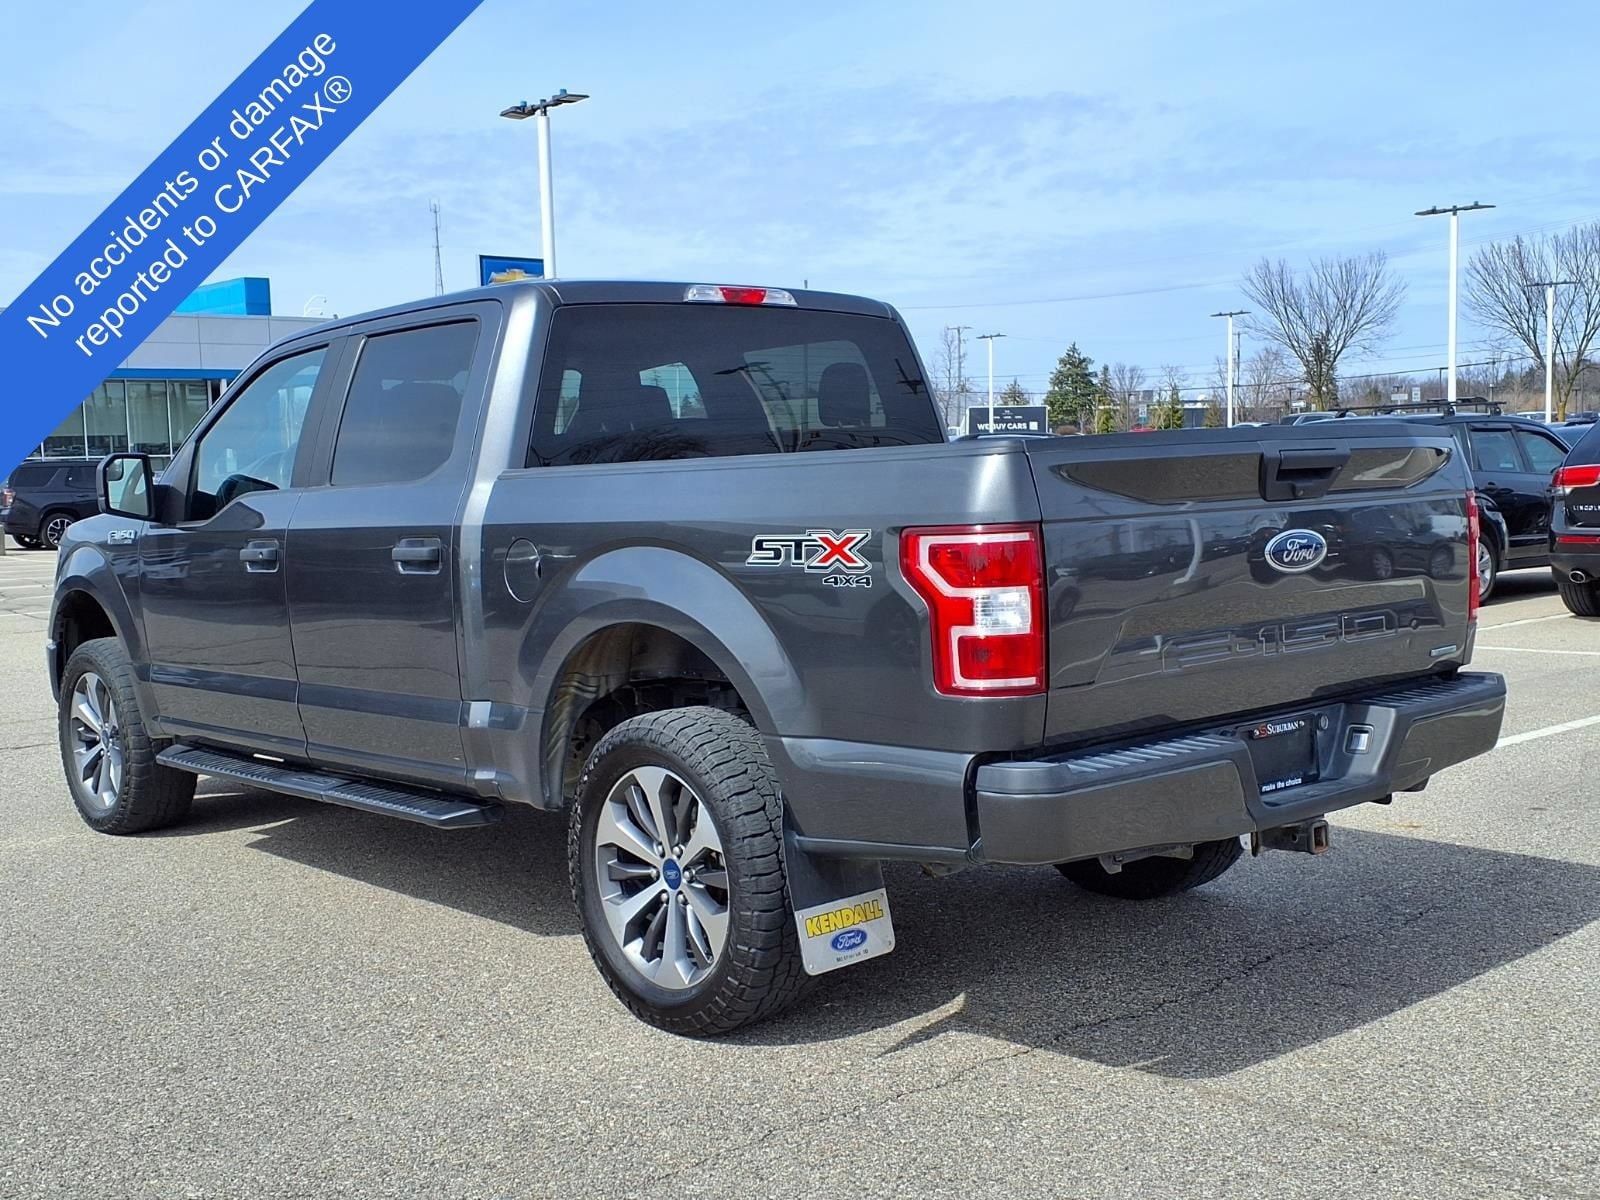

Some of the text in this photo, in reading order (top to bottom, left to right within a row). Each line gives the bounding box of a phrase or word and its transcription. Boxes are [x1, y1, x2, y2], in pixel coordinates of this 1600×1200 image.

[1007, 422, 1027, 430] CARS
[746, 529, 872, 573] STX
[1282, 538, 1317, 563] Ford
[1261, 778, 1302, 792] make the choice
[805, 900, 883, 938] KENDALL
[836, 932, 862, 949] Ford
